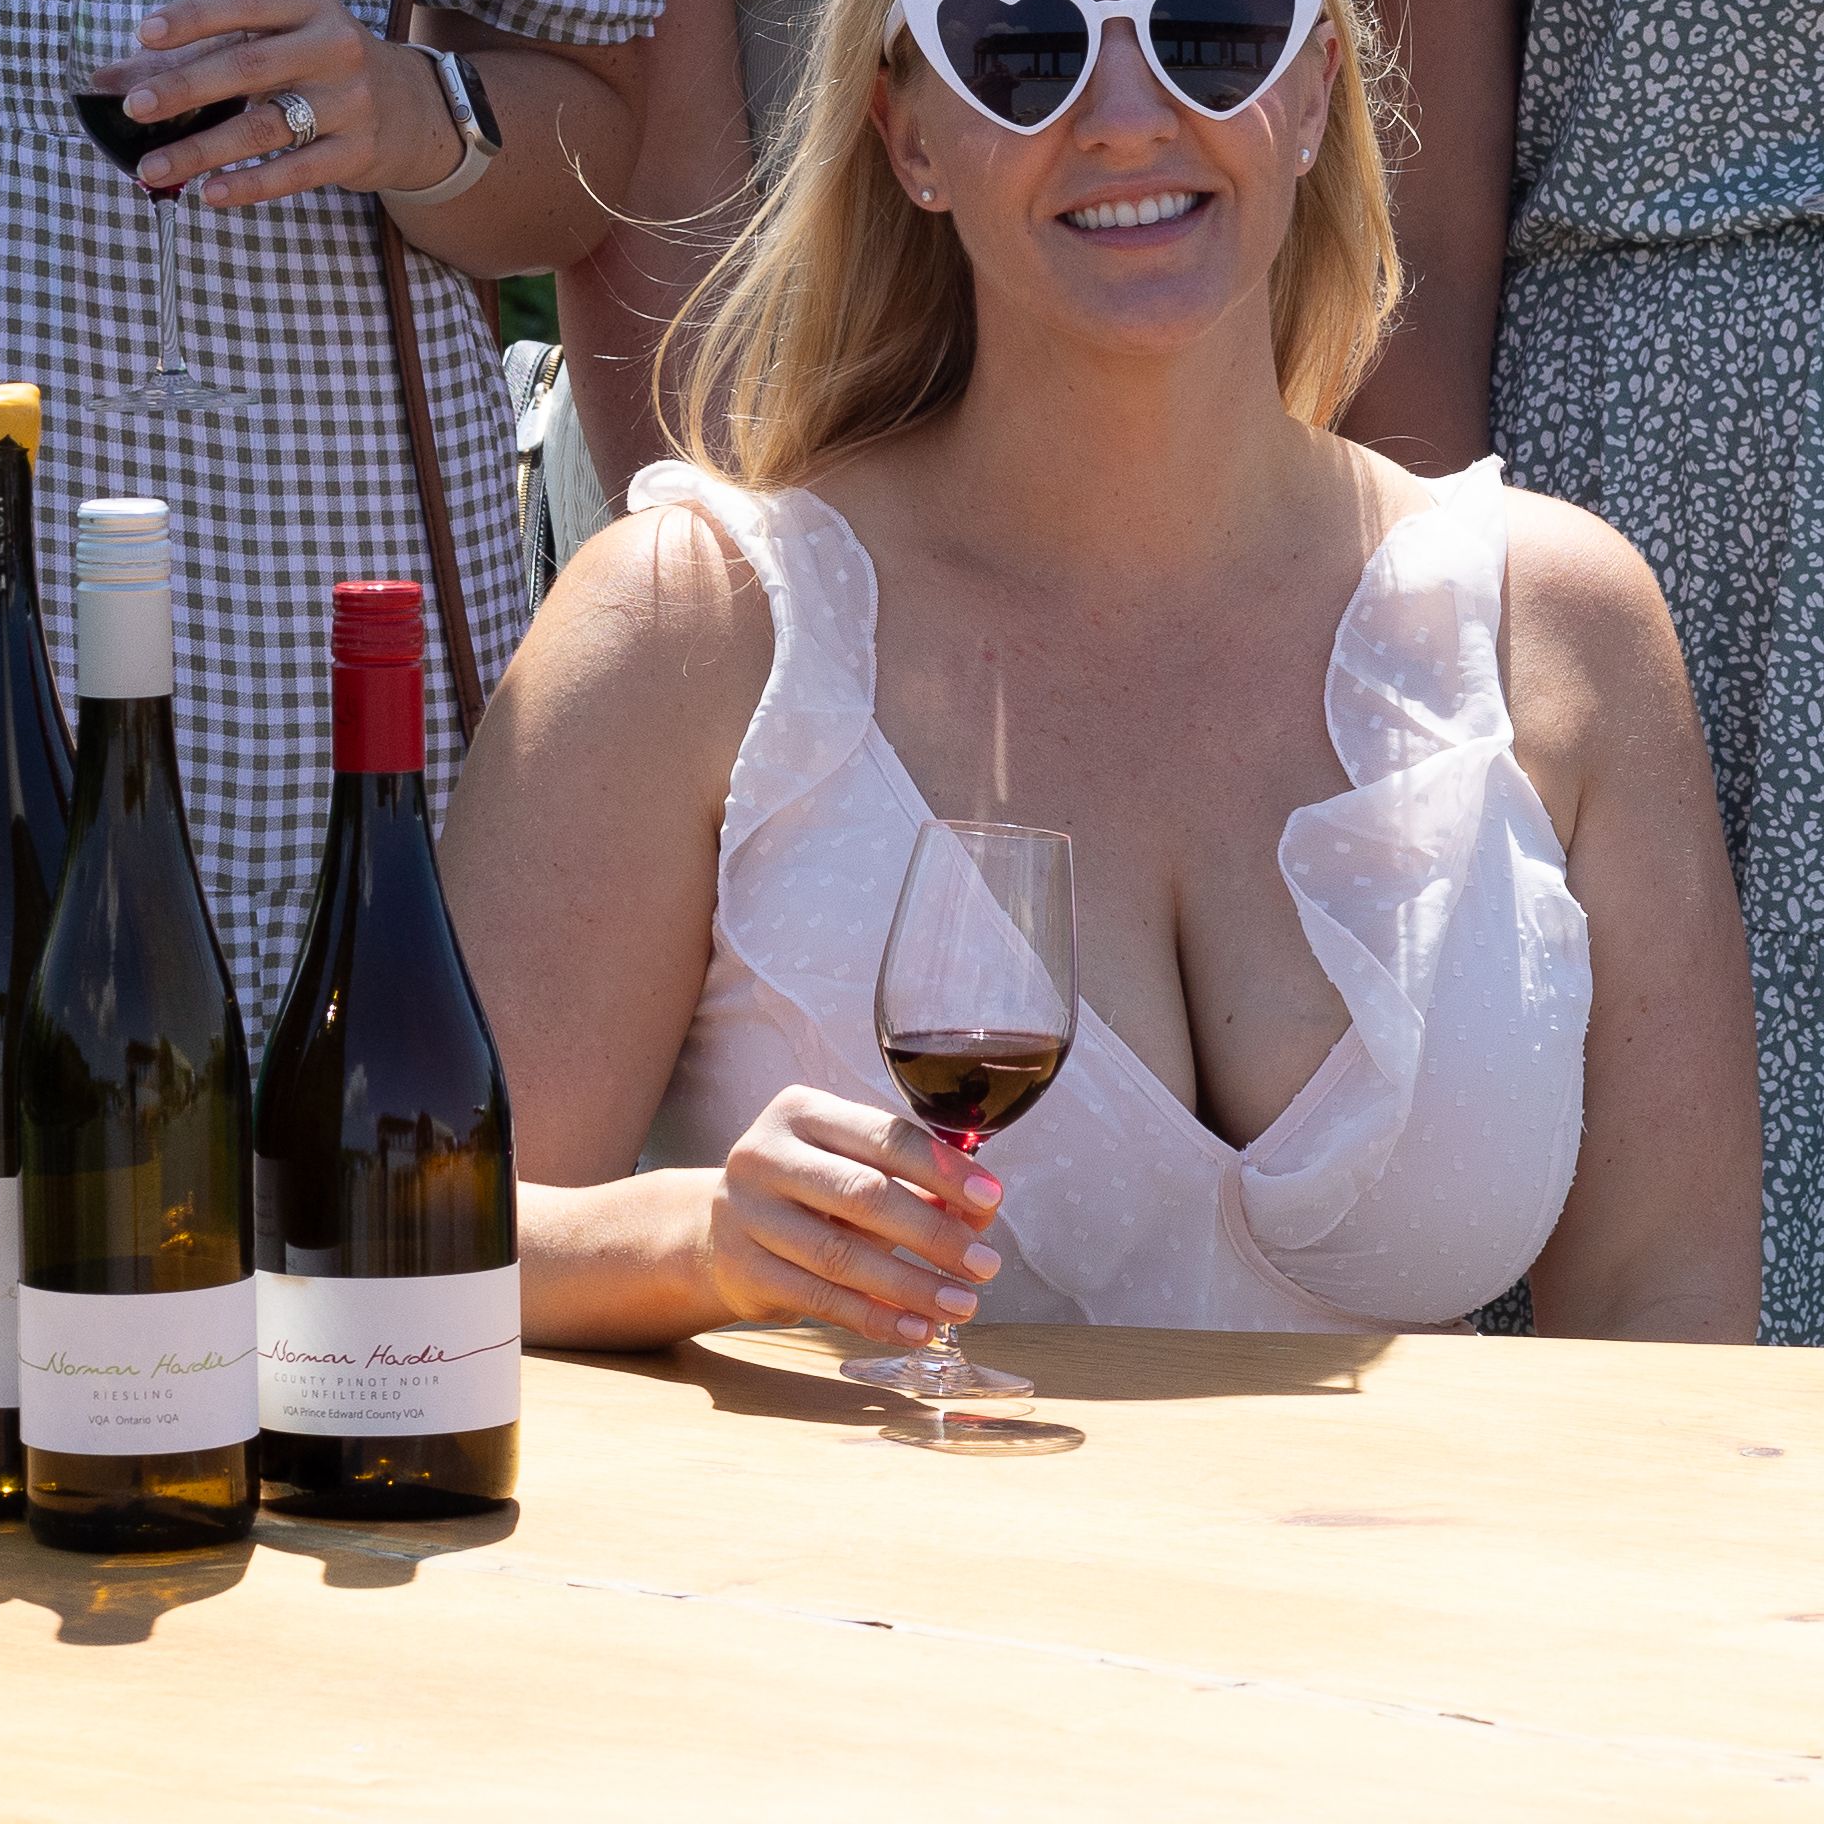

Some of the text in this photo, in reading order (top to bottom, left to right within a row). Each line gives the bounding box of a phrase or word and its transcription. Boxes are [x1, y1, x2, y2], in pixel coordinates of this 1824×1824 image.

[272, 1339, 447, 1369] Norman Hardie
[45, 1351, 228, 1379] Norman Hardie
[274, 1372, 440, 1387] COUNTY PINOT NOIR
[93, 1389, 174, 1401] RIESLING
[301, 1389, 401, 1401] UNFILTERED
[88, 1414, 180, 1425] VQA Ontario VQA
[282, 1406, 425, 1421] VQA Prince Edward County VQA
